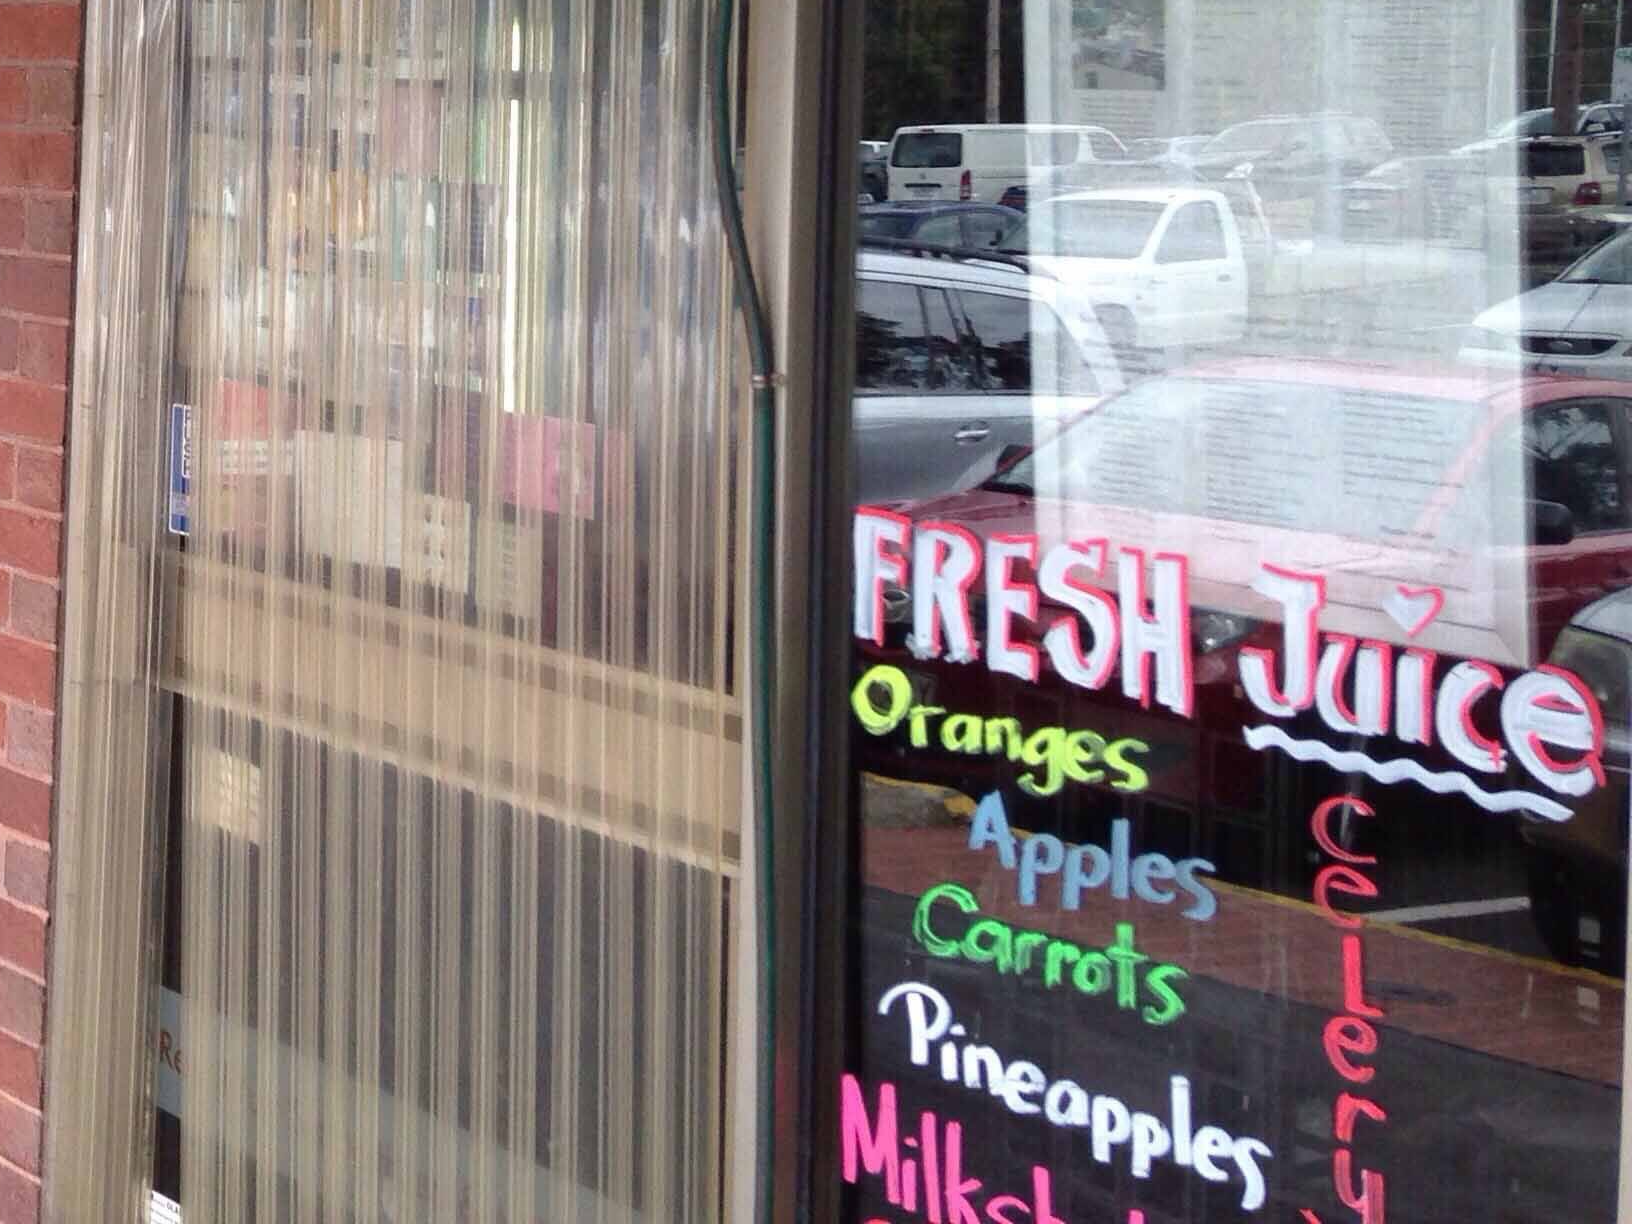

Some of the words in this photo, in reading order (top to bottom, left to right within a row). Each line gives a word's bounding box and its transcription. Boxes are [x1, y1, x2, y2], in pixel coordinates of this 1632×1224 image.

[853, 505, 1196, 718] FRESH
[1239, 561, 1607, 798] Juice
[851, 663, 1150, 797] Oranges
[969, 788, 1219, 922] Apples
[912, 883, 1190, 1025] Carrots
[877, 981, 1272, 1212] Pineapples
